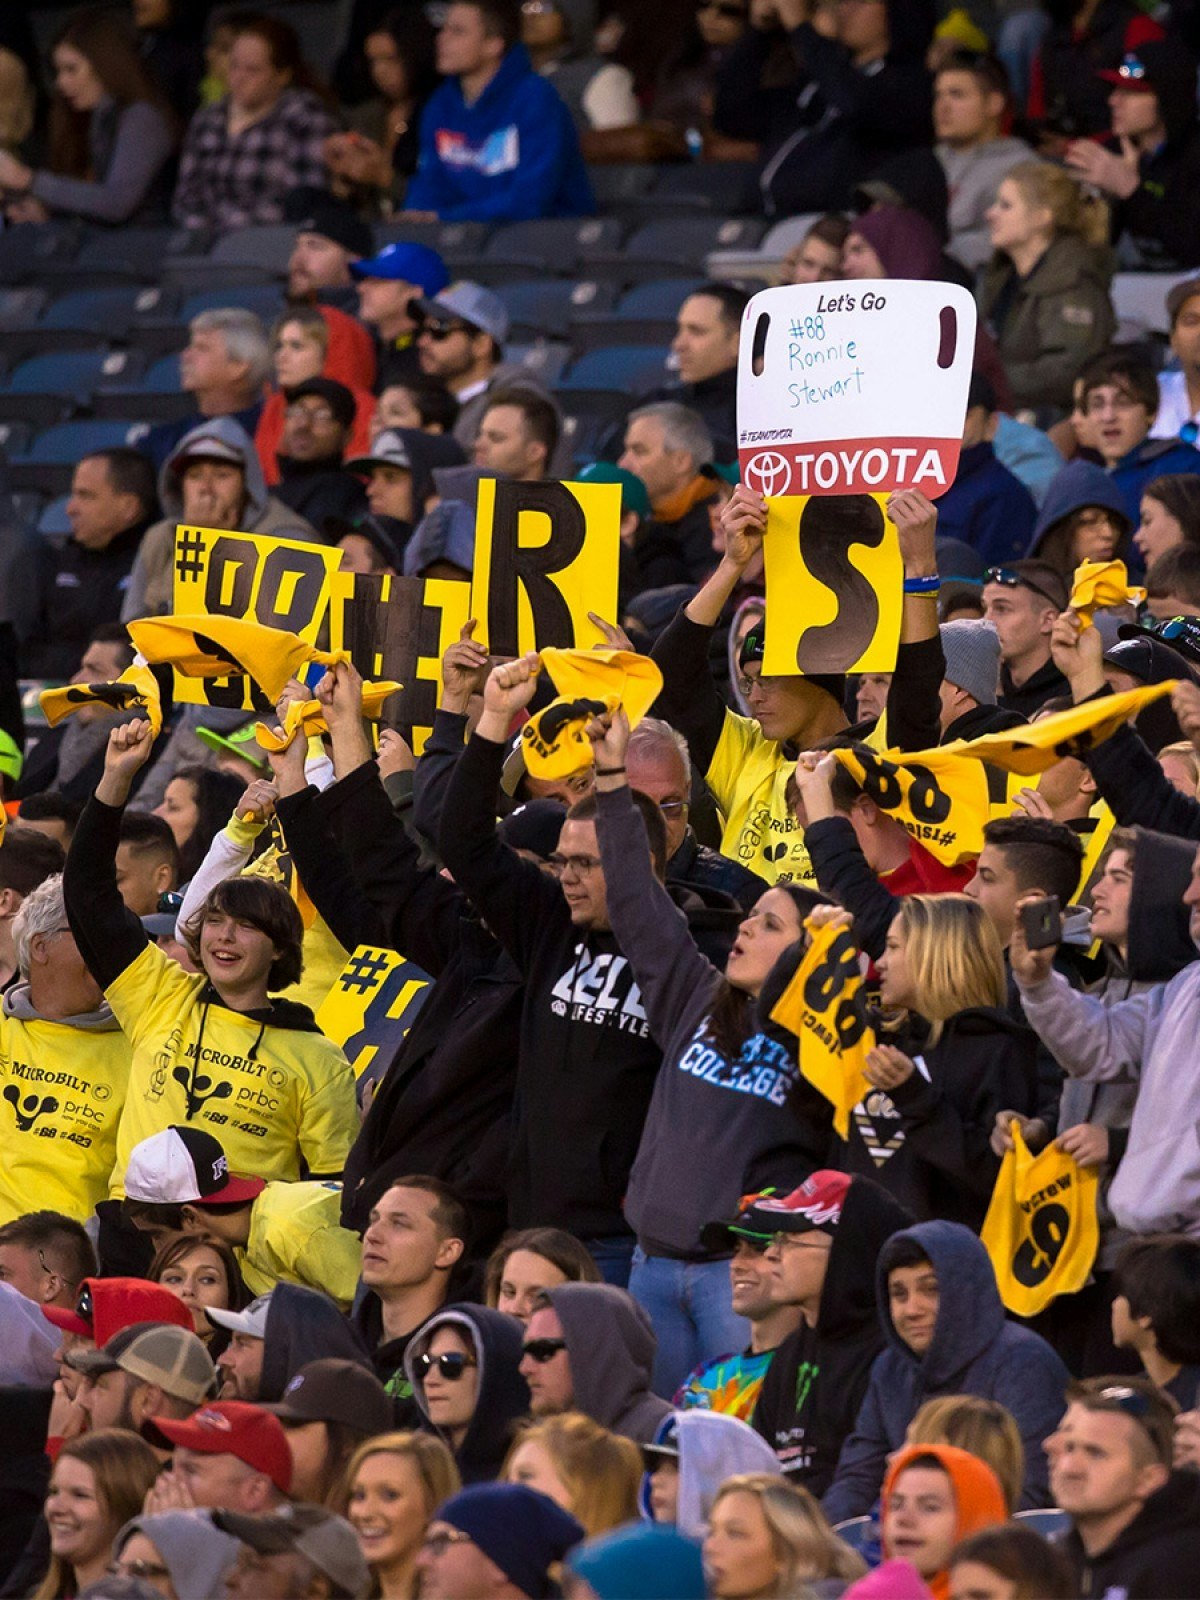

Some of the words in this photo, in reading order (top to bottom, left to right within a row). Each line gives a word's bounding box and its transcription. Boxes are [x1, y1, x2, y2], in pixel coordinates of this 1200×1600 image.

[816, 294, 856, 313] Let's
[860, 292, 887, 311] Go
[788, 315, 826, 341] #88
[788, 340, 857, 371] Ronnie
[787, 367, 865, 408] Stewart
[795, 448, 946, 490] TOYOTA
[488, 479, 586, 658] R
[796, 494, 885, 674] S
[184, 1043, 267, 1077] MCROBILT
[11, 1061, 91, 1094] MICROBILT
[63, 1100, 105, 1123] prbc
[237, 1087, 280, 1112] prbc
[60, 1131, 93, 1149] #423
[230, 1119, 268, 1137] #423
